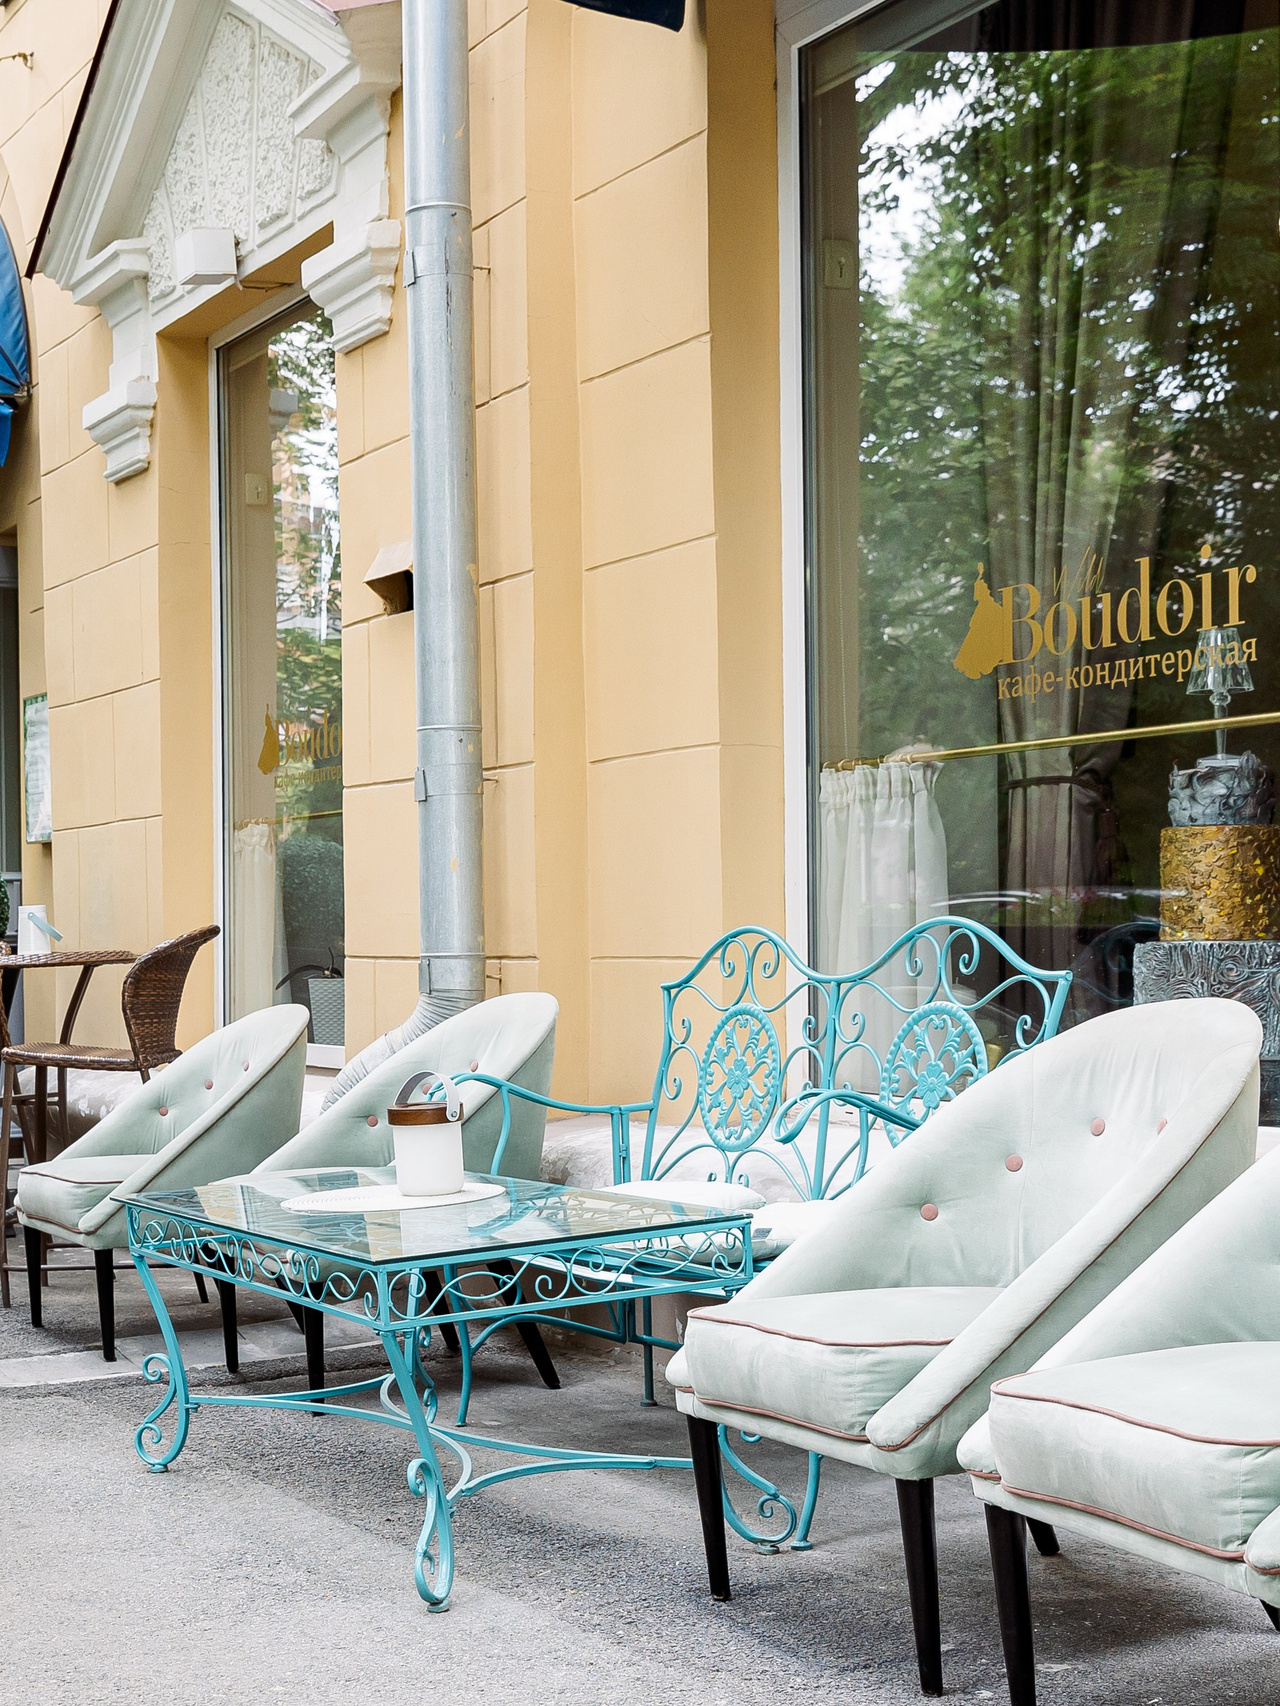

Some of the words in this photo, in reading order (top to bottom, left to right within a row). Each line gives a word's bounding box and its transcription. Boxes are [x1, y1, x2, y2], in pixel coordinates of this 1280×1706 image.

[998, 543, 1257, 666] Boudoir
[997, 637, 1258, 703] кафе-кондитерская
[275, 706, 342, 768] Boudo
